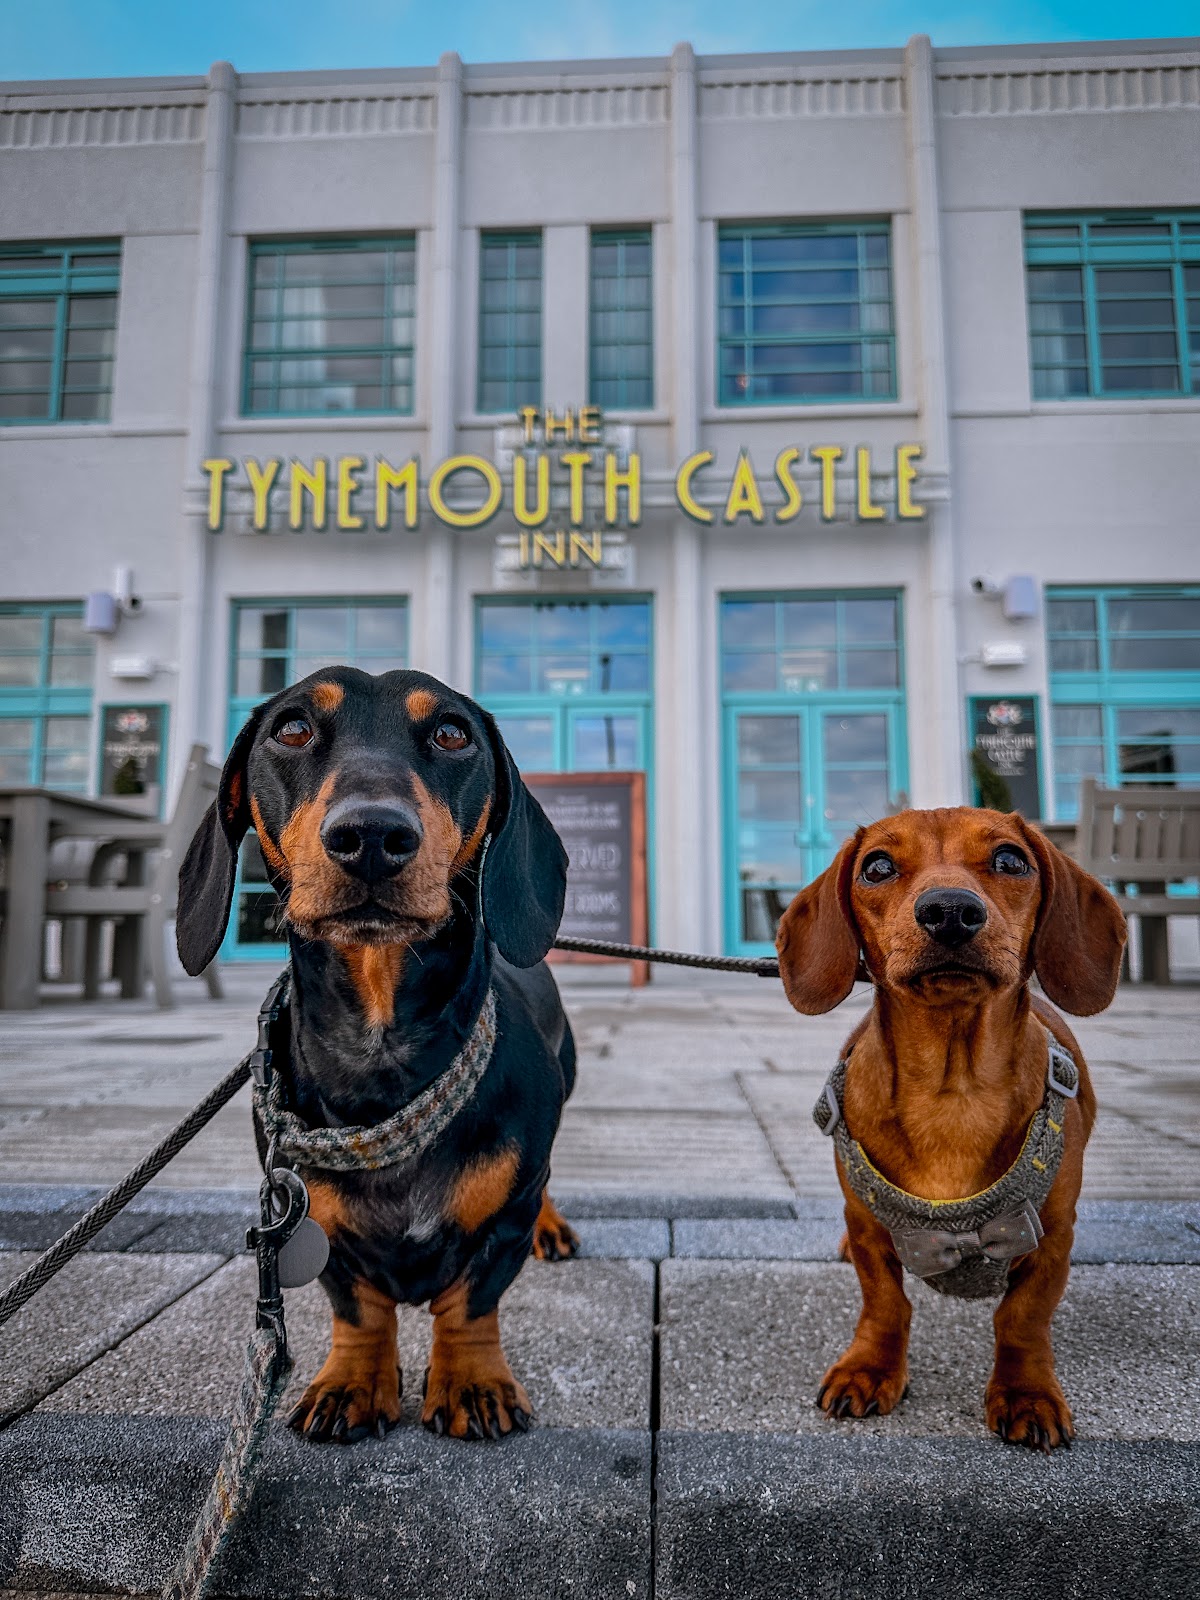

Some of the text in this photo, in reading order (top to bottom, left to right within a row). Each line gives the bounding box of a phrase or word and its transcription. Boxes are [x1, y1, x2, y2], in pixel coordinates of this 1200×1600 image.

[520, 406, 602, 445] THE
[203, 445, 926, 529] TYNEMOUTH CASTLE
[519, 530, 602, 568] INN
